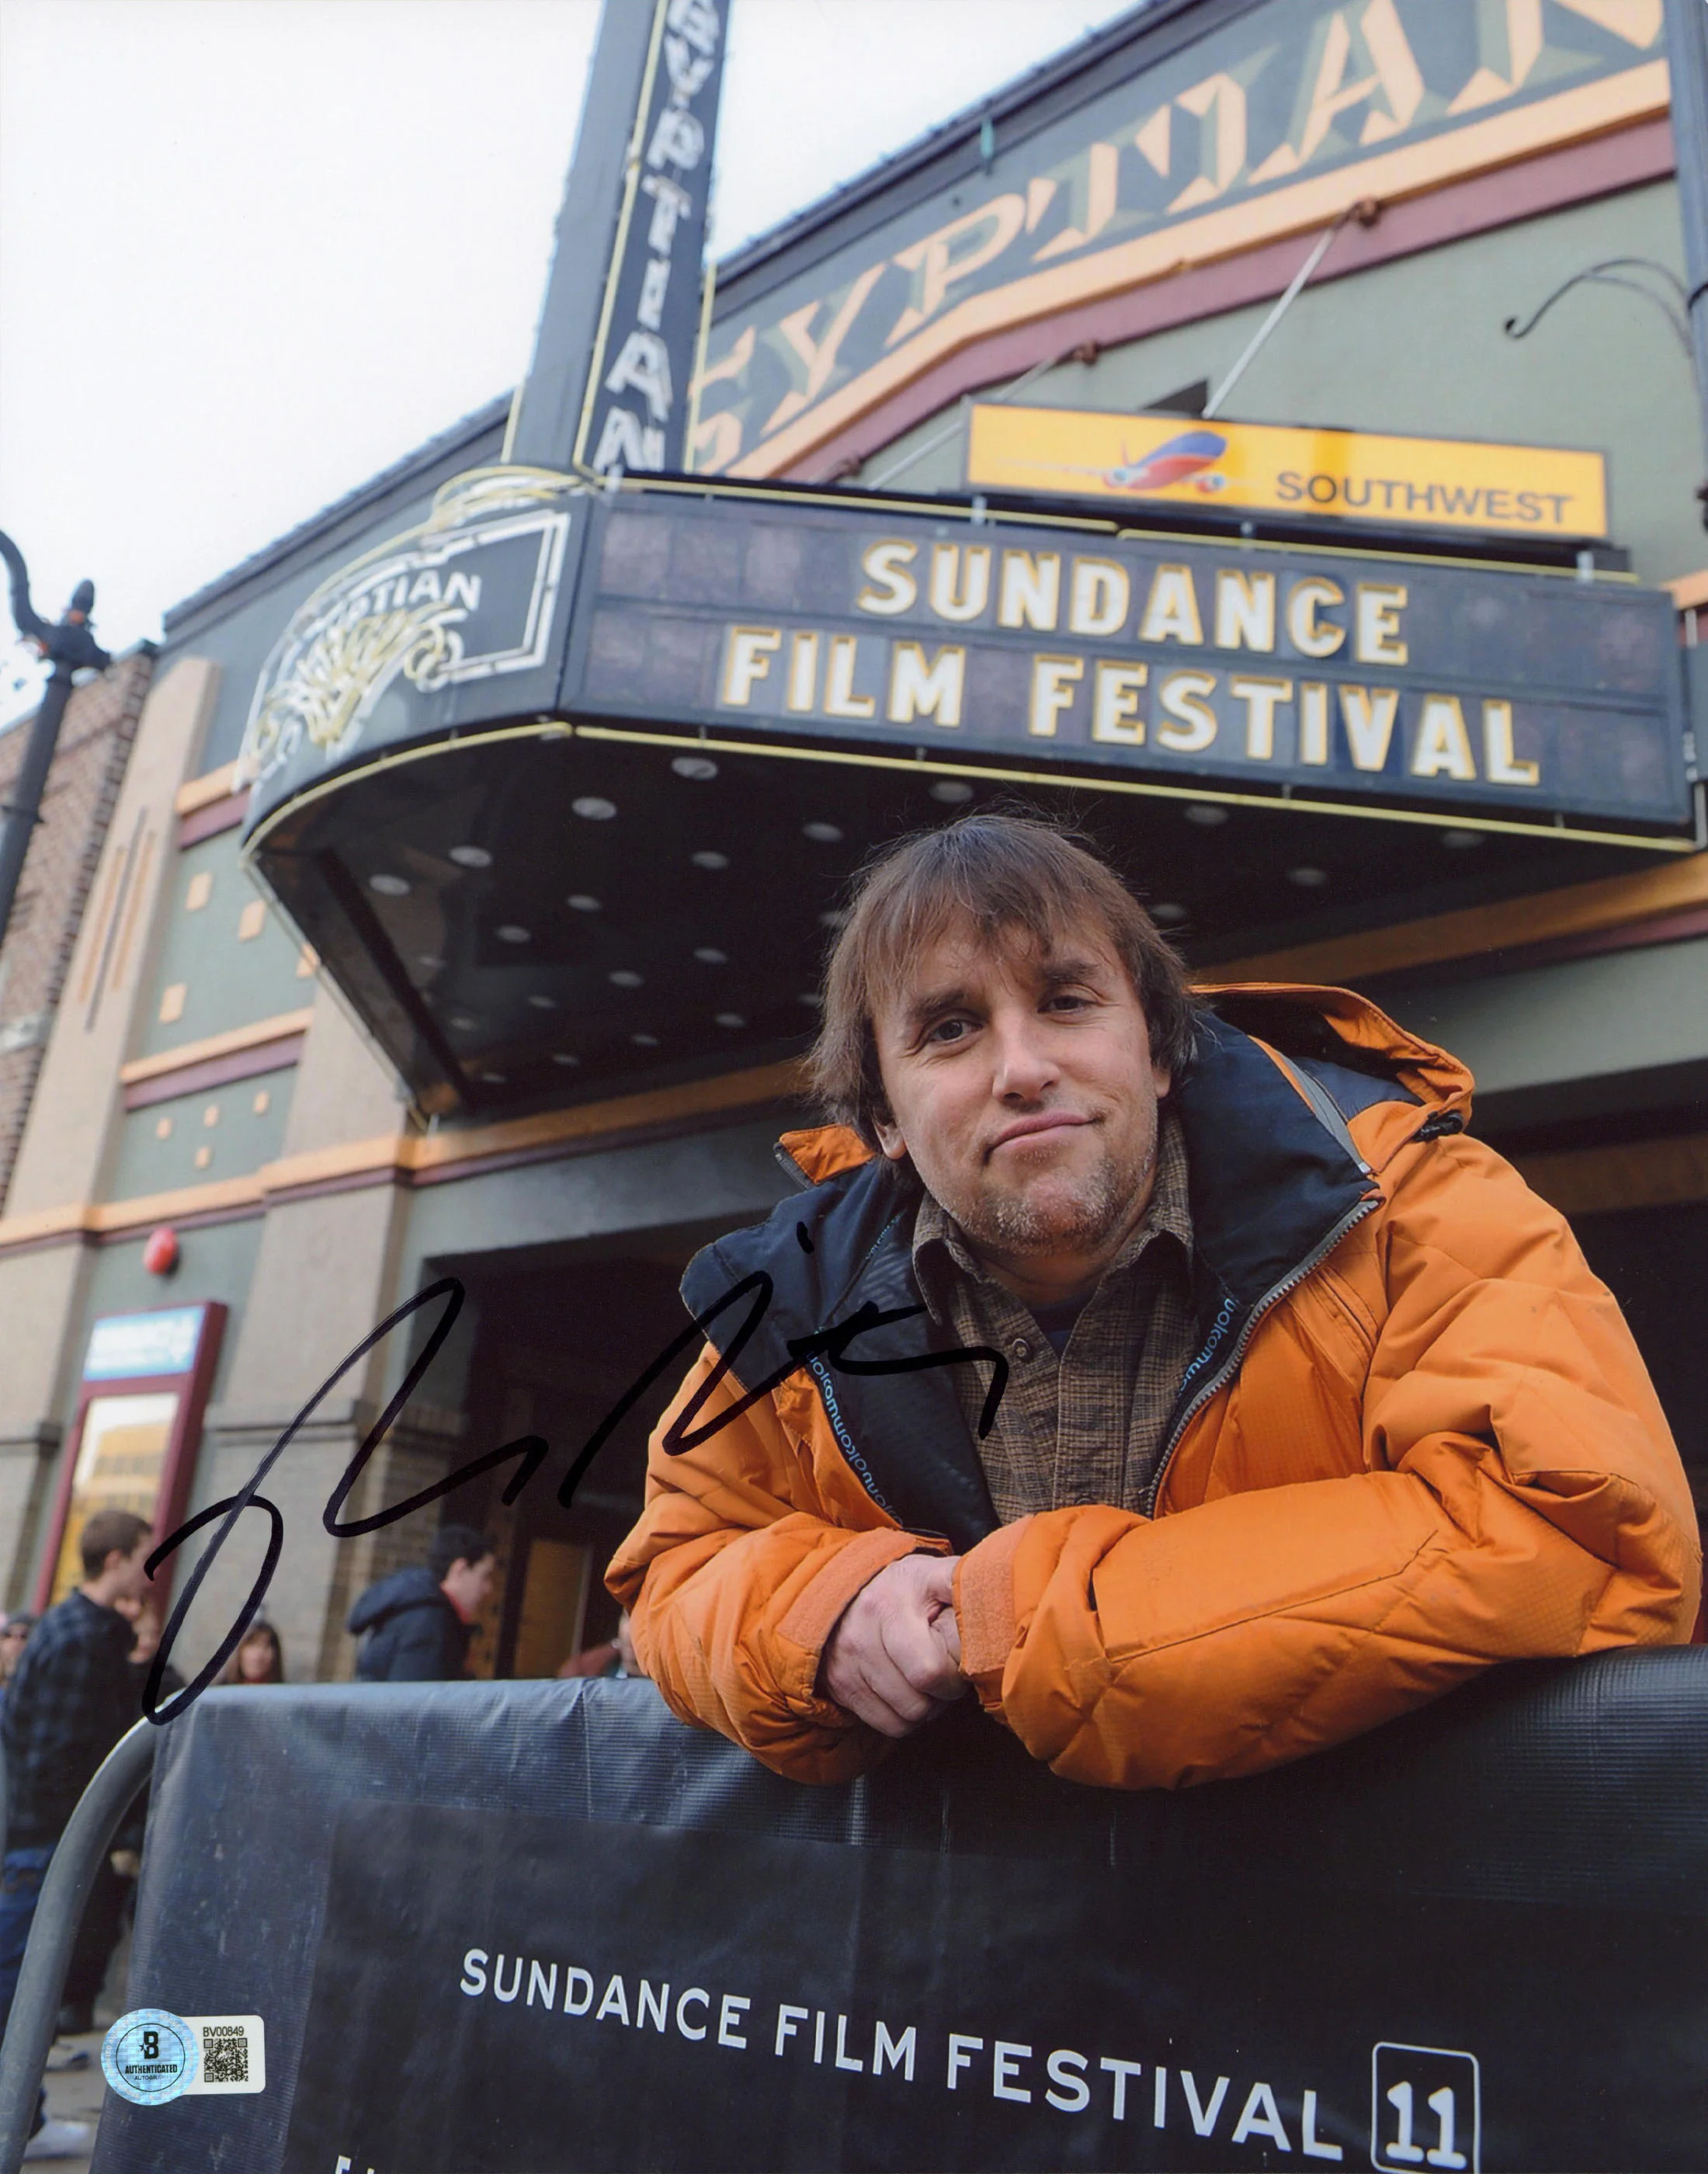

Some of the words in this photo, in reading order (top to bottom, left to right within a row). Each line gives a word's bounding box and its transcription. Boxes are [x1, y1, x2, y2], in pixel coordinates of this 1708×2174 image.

[1276, 471, 1574, 524] SOUTHWEST
[857, 537, 1409, 666] SUNDANCE
[720, 626, 967, 728] FILM
[1027, 652, 1540, 787] FESTIVAL
[460, 1948, 751, 2049] SUNDANCE
[775, 2003, 917, 2082] FILM
[947, 2033, 1342, 2161] FESTIVAL
[1386, 2082, 1467, 2169] 11
